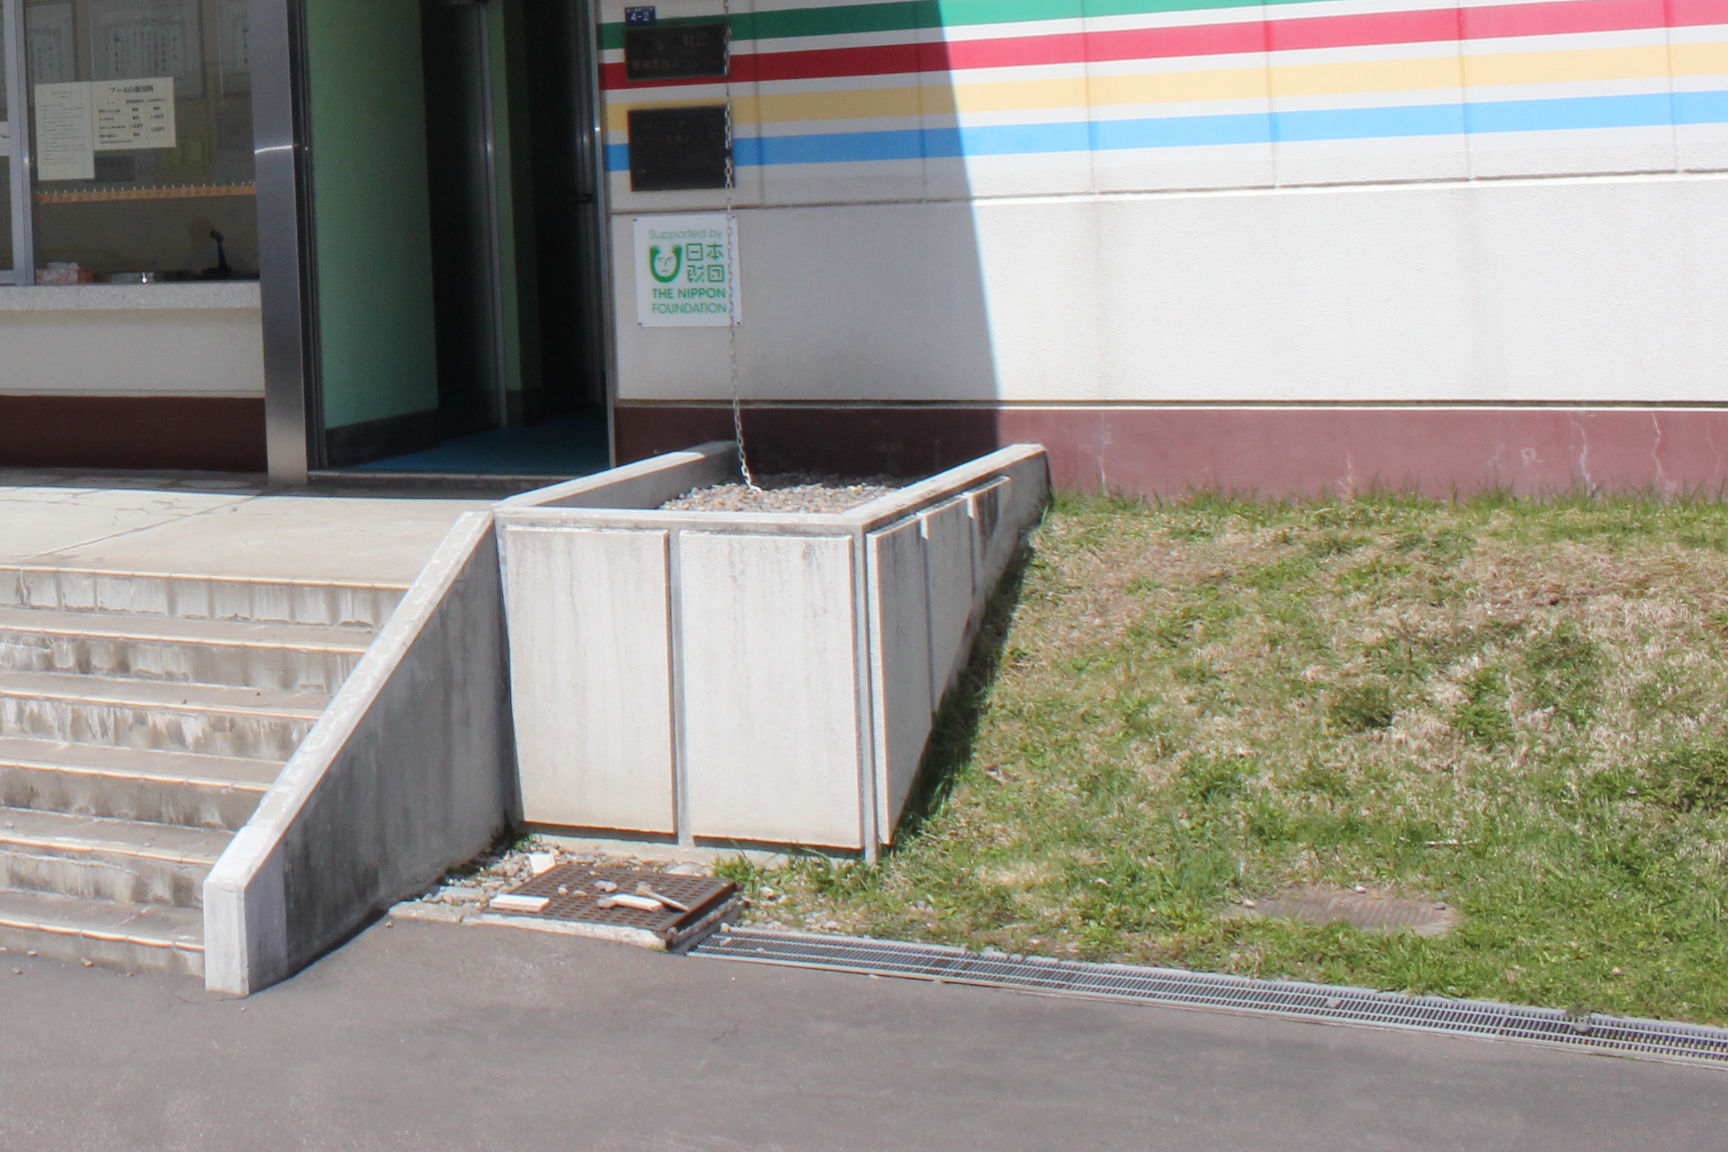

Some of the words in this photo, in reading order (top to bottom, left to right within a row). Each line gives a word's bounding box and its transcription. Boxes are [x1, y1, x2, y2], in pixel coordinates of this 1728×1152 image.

[630, 11, 650, 22] 4-2
[649, 229, 706, 241] Supported
[709, 228, 723, 240] by
[686, 242, 724, 261] 日本
[652, 288, 674, 299] THE
[677, 287, 726, 299] NIPPON
[652, 302, 727, 314] FOUNDATION
